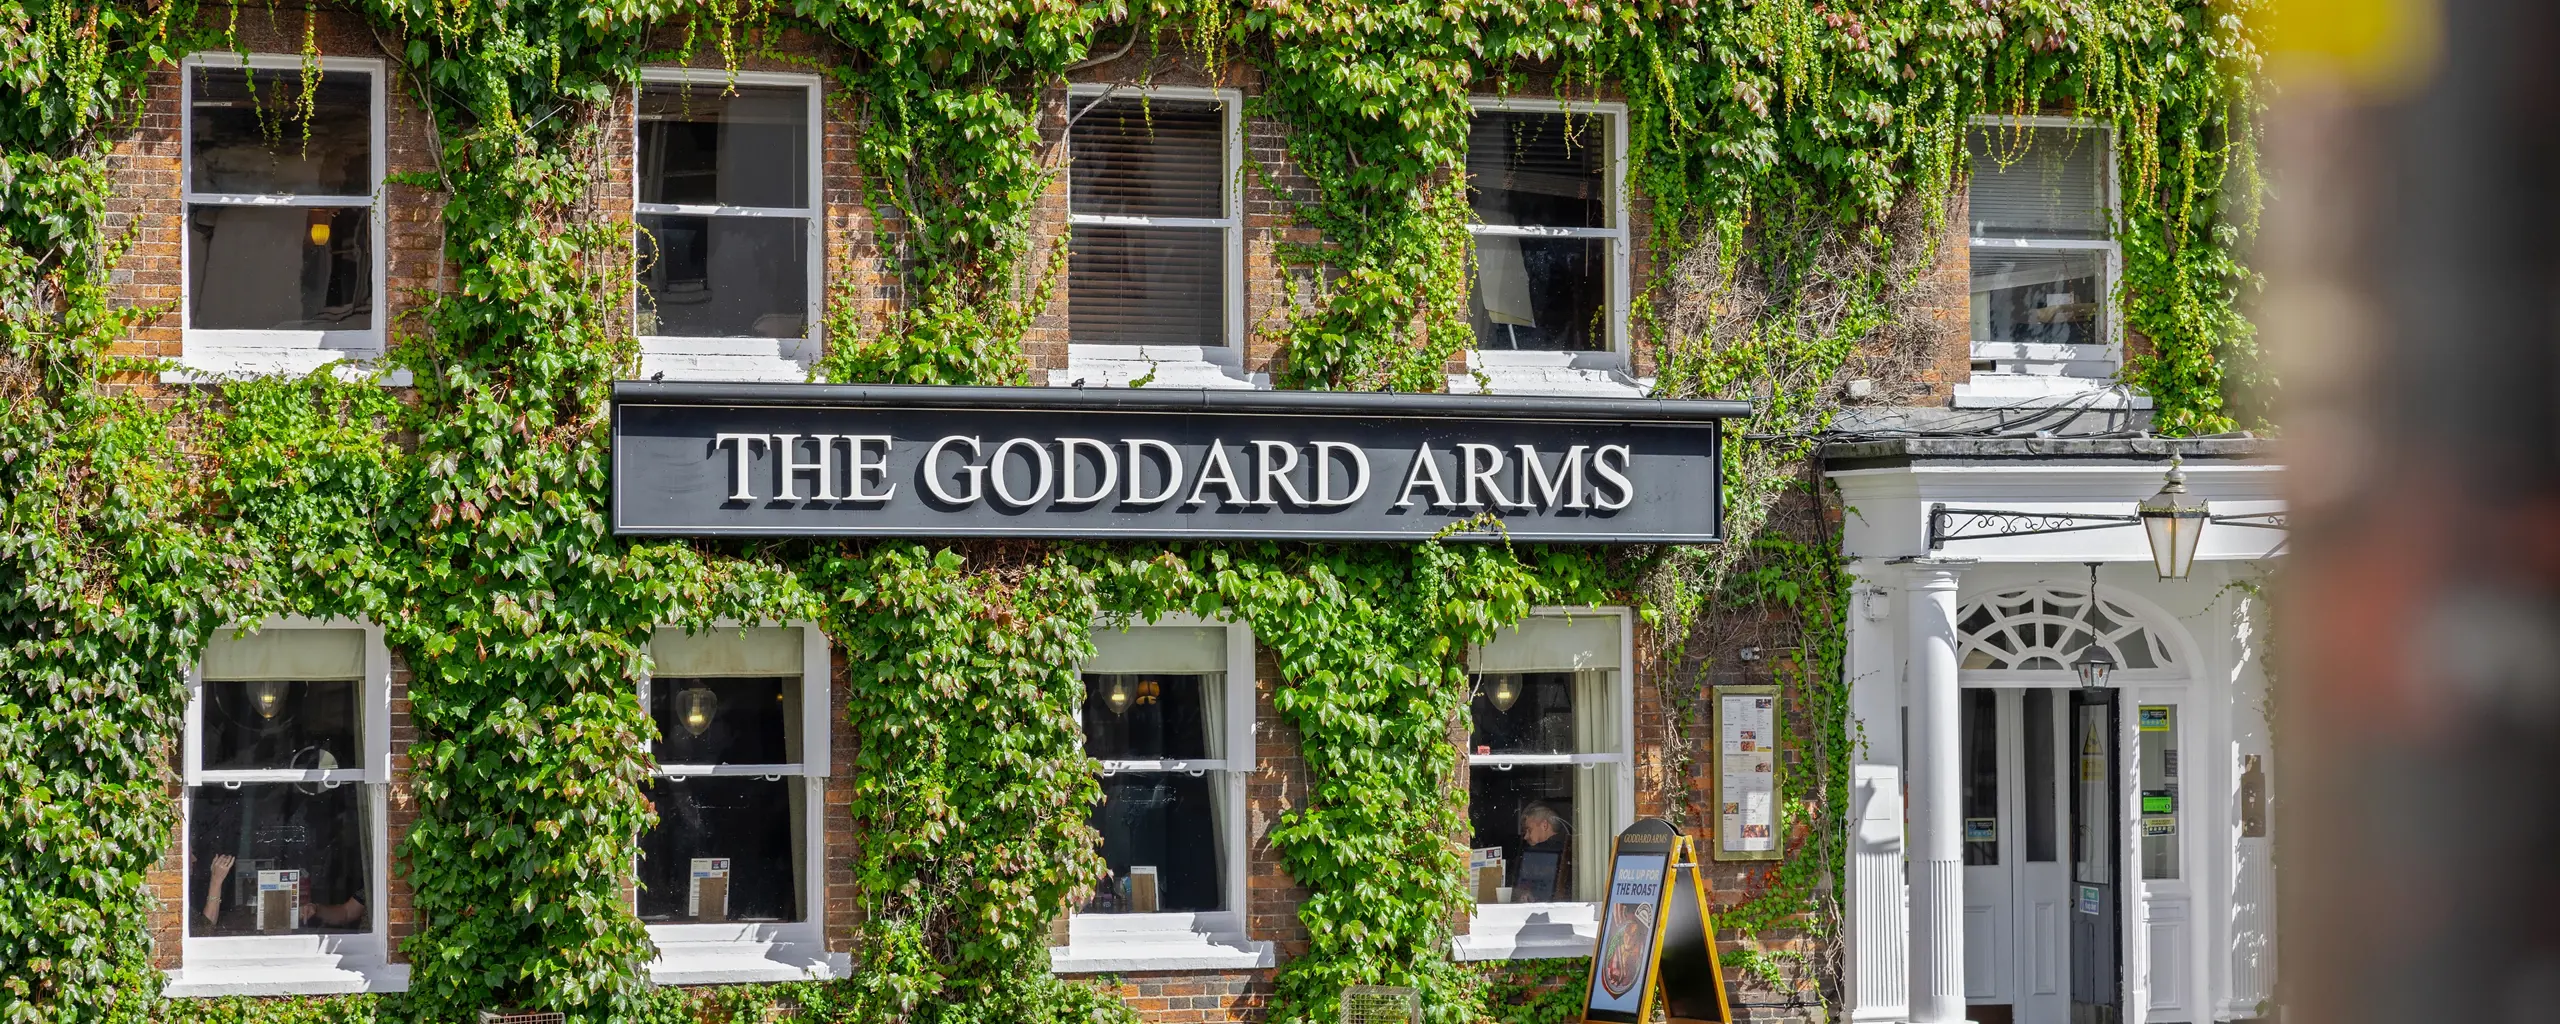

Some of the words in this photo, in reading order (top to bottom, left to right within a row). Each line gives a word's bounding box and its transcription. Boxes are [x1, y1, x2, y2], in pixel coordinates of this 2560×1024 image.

[716, 433, 897, 502] THE
[923, 435, 1371, 507] GODDARD
[1394, 442, 1634, 511] ARMS
[1624, 834, 1651, 843] GODDARD
[1651, 833, 1667, 844] ARMS
[1619, 868, 1634, 880] ROLL
[1636, 869, 1646, 880] UP
[1646, 869, 1659, 880] FOR
[1616, 883, 1631, 895] THE
[1631, 883, 1657, 896] ROAST
